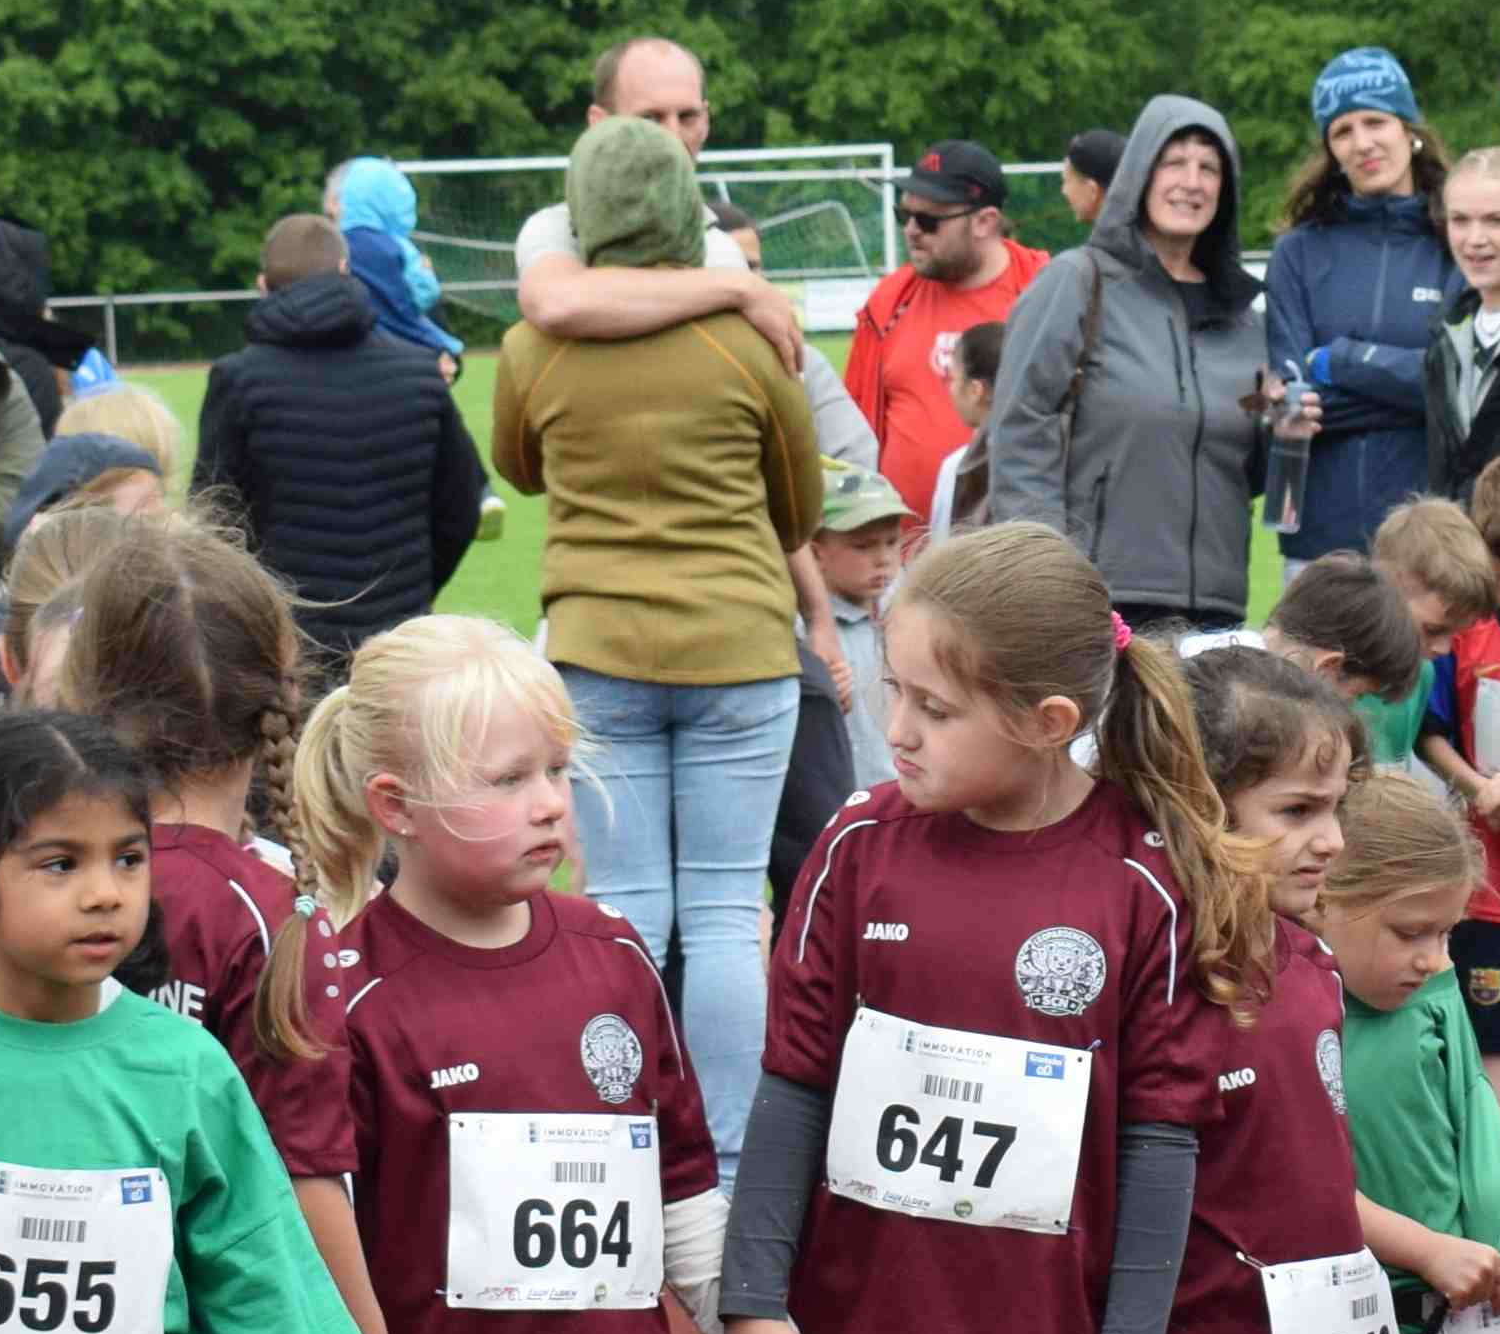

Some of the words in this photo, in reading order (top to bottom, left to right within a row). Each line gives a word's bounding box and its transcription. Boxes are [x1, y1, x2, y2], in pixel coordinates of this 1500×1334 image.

[863, 922, 909, 942] JAKO
[918, 1040, 993, 1059] IMMOVATION
[430, 1063, 479, 1089] JAKO
[1217, 1067, 1257, 1092] AKO
[543, 1128, 611, 1139] IMMOVATION
[875, 1103, 1018, 1189] 647
[14, 1180, 93, 1195] IMMOVATION
[513, 1198, 632, 1268] 664
